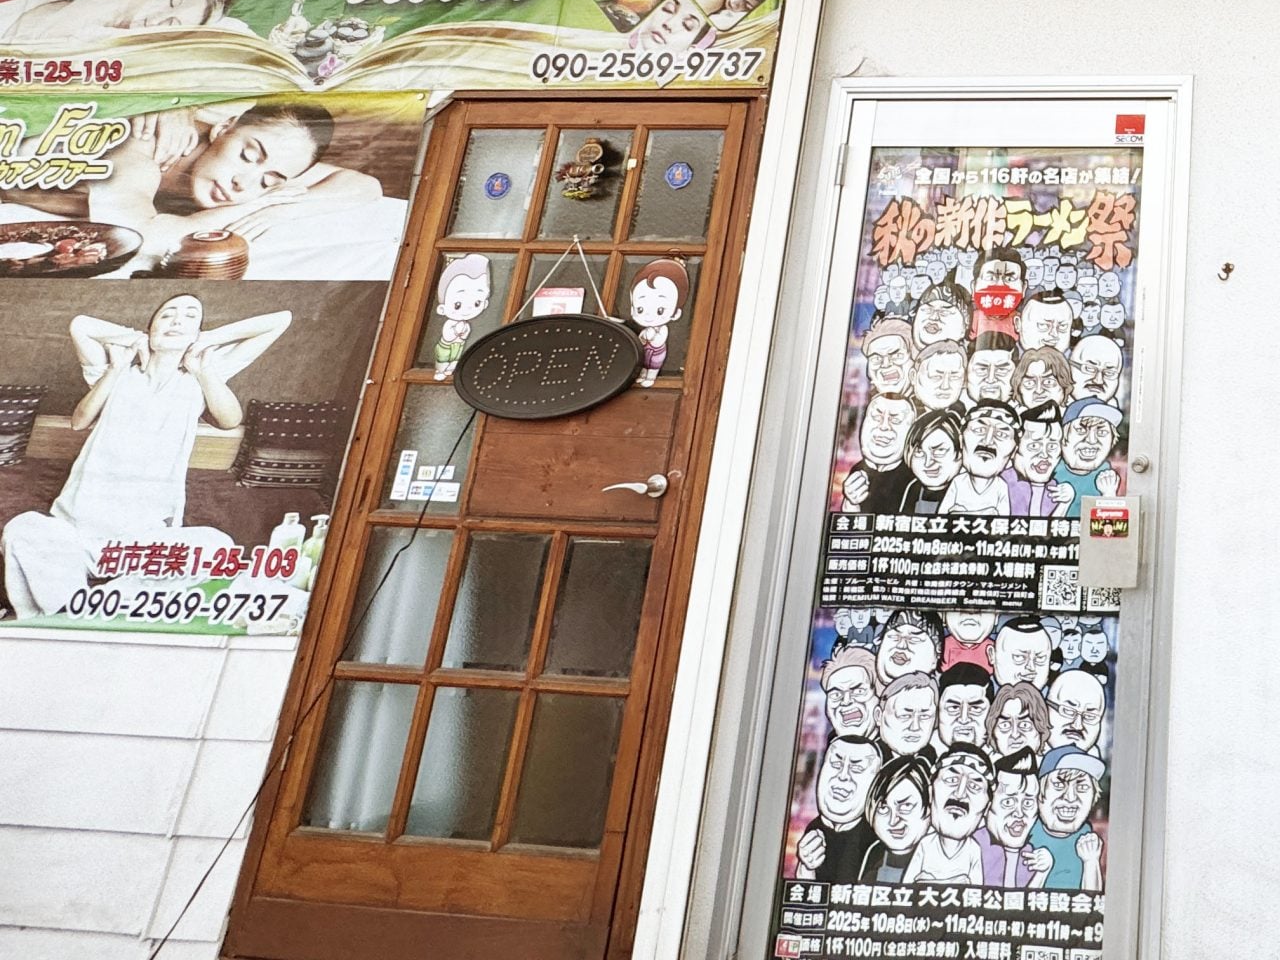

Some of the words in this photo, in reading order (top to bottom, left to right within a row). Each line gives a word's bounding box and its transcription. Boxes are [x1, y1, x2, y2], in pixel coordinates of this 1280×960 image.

[532, 51, 762, 78] 090-2569-9737
[35, 105, 127, 157] Far
[868, 189, 1138, 272] 秋の新作ラーメン祭
[473, 343, 621, 393] OPEN
[836, 516, 868, 531] 会場
[875, 514, 949, 534] 新宿区立
[951, 516, 1049, 537] 大久保公園
[69, 589, 288, 621] 090-2569-9737
[881, 595, 905, 603] WATER
[789, 884, 823, 903] 会場
[830, 884, 914, 907] 新宿区立
[917, 886, 1025, 911] 大久保公園
